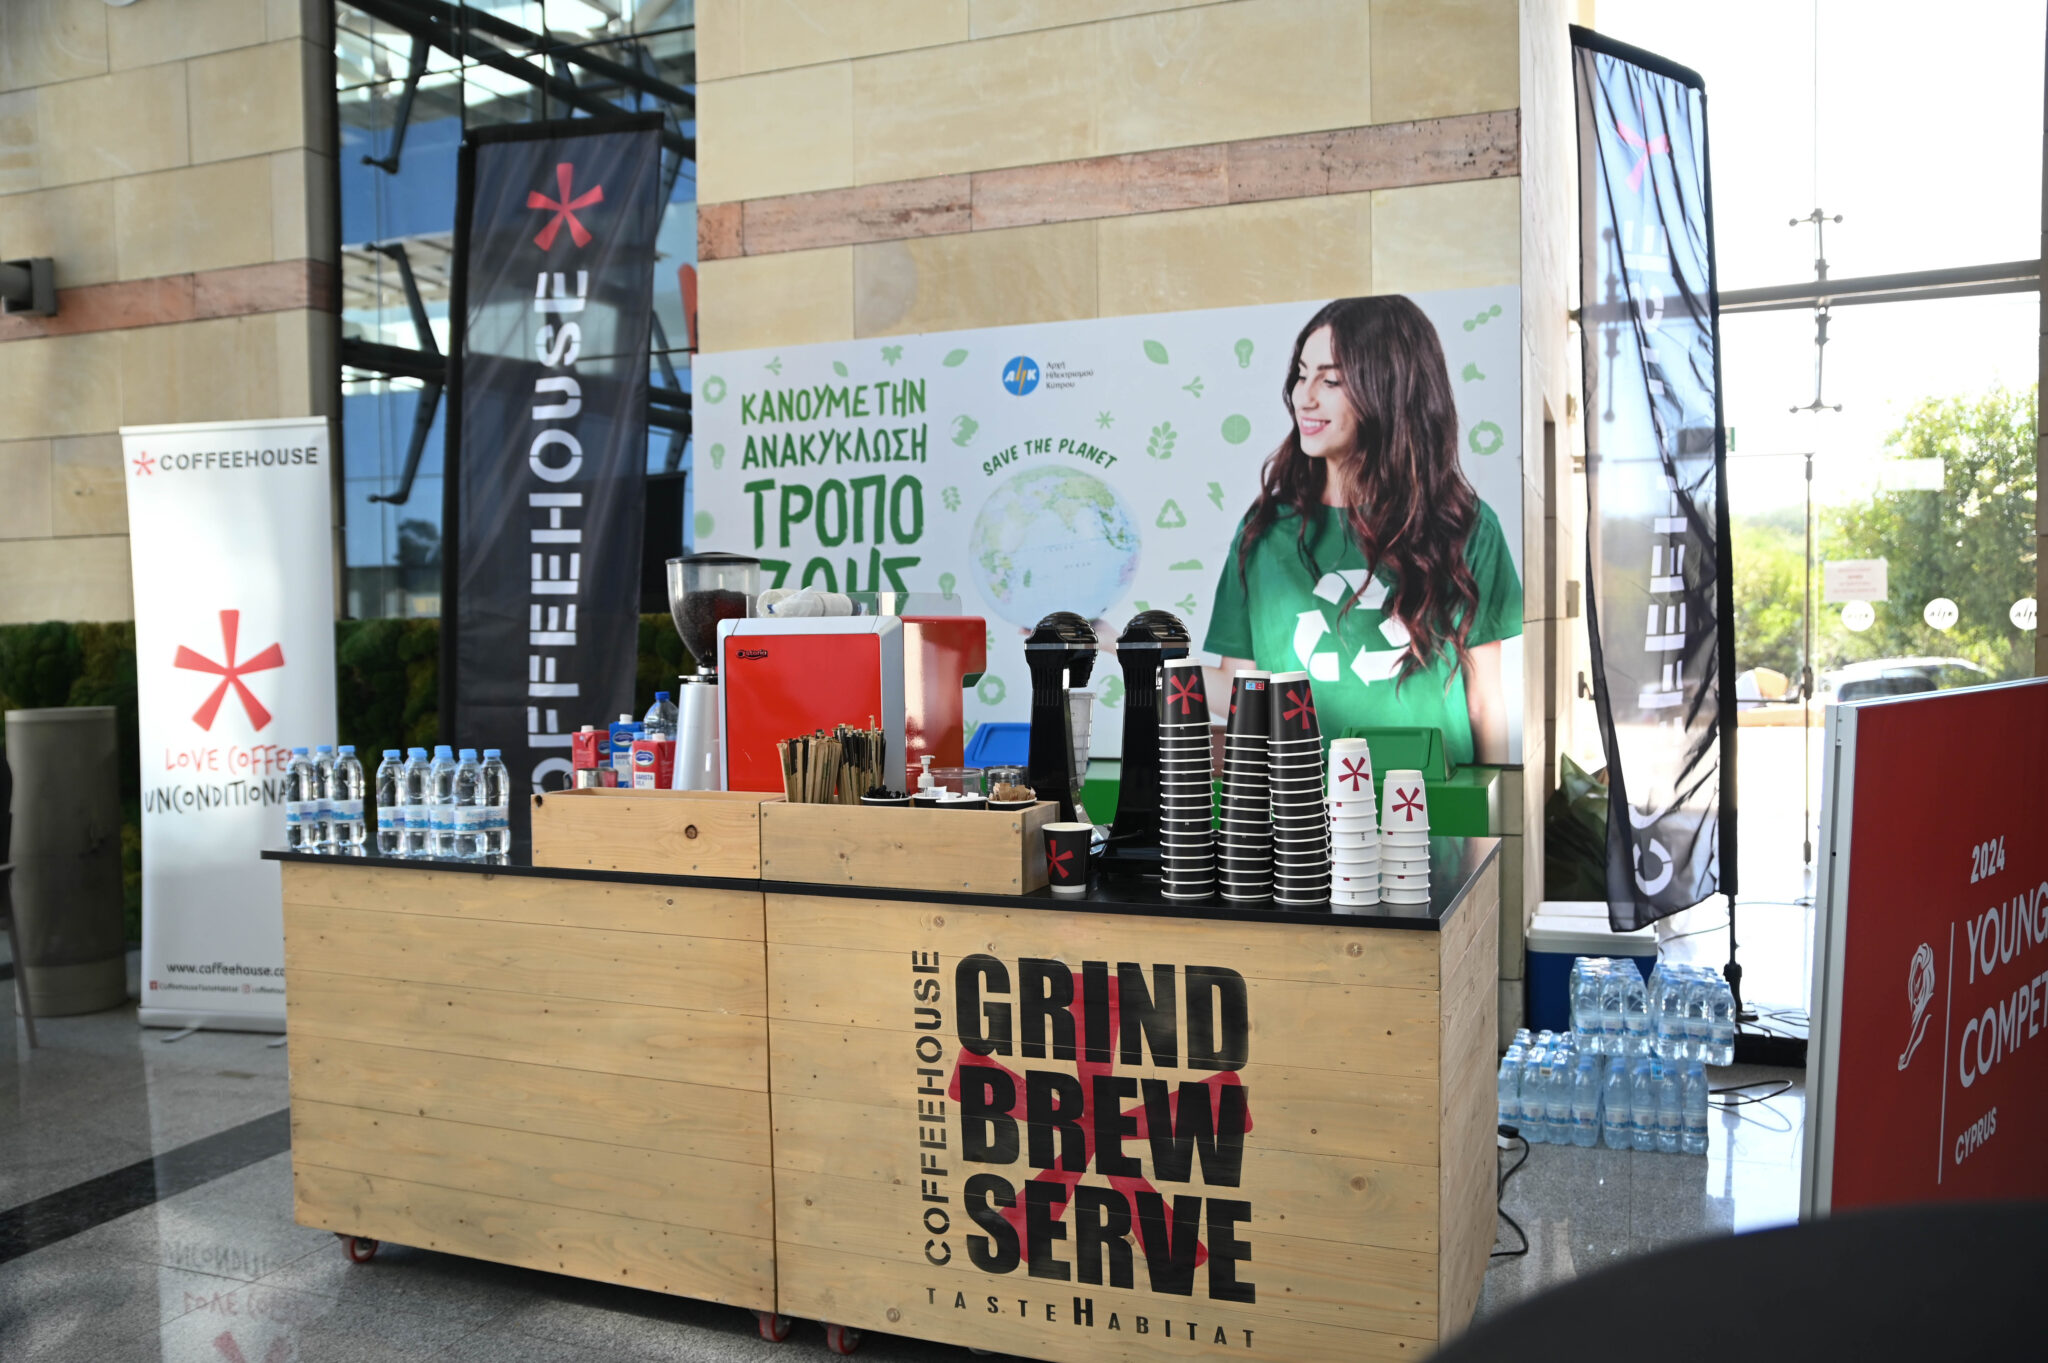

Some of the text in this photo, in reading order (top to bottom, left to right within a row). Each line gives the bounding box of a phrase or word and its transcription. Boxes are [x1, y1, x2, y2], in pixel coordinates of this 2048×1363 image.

[741, 378, 926, 425] ΚΑΝΟΥΜΕ ΤΗΝ
[160, 447, 318, 471] COFFEEHOUSE
[741, 422, 928, 470] ΑΝΑΚΥΚΛΩΣΗ
[982, 437, 1118, 477] SAVE THE PLANET
[527, 269, 589, 796] OFFEEHOUSE
[743, 474, 924, 549] ΤΡΟΠΟ
[165, 744, 293, 775] LOVE COFFE
[145, 779, 287, 814] UNCONDITIONA
[1971, 835, 2006, 883] 2024
[1967, 881, 2048, 984] YOUNG
[955, 953, 1249, 1072] GRIND
[912, 950, 951, 1266] COFFEEHOUSE
[959, 1064, 1249, 1188] BREW
[1955, 1106, 1998, 1165] CYPRUS
[963, 1173, 1256, 1304] SERVE
